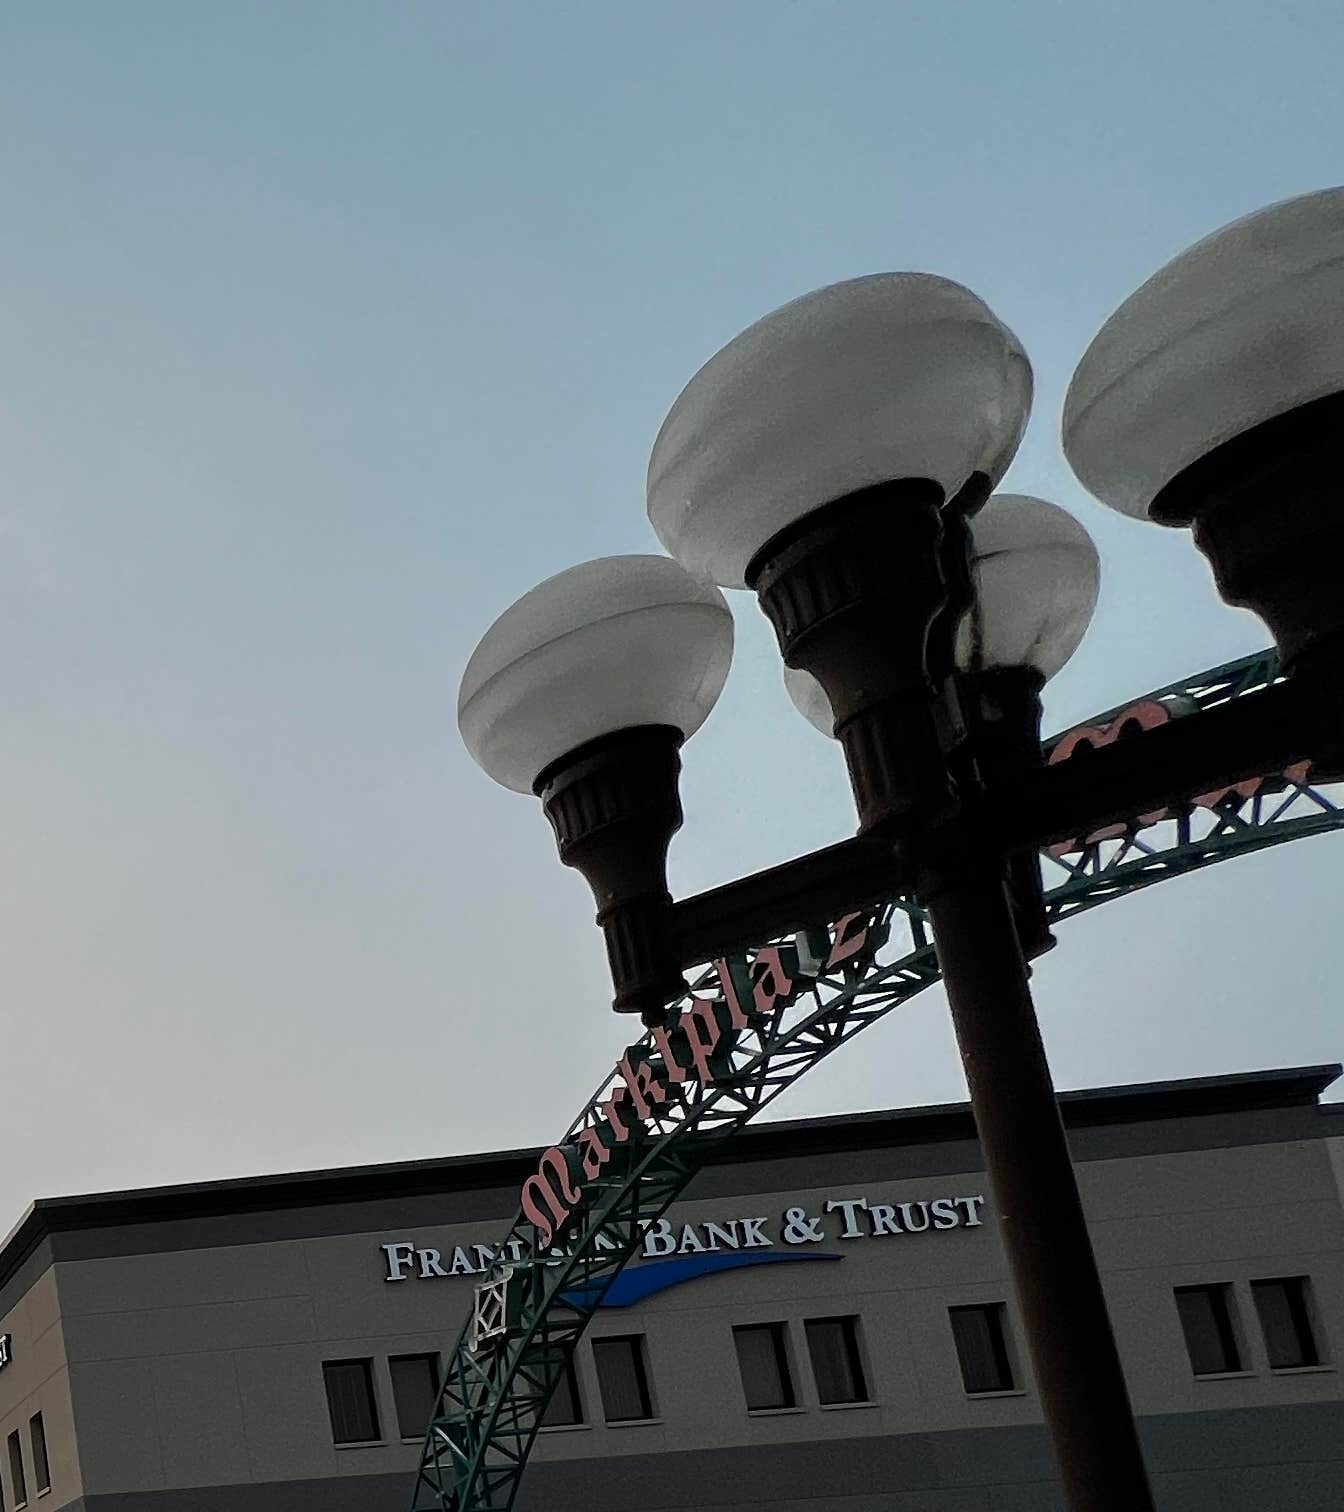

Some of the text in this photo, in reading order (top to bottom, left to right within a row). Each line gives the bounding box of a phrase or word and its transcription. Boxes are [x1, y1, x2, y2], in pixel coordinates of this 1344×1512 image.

[640, 1217, 774, 1258] BANK
[783, 1206, 825, 1245] &
[826, 1196, 985, 1239] TRUST
